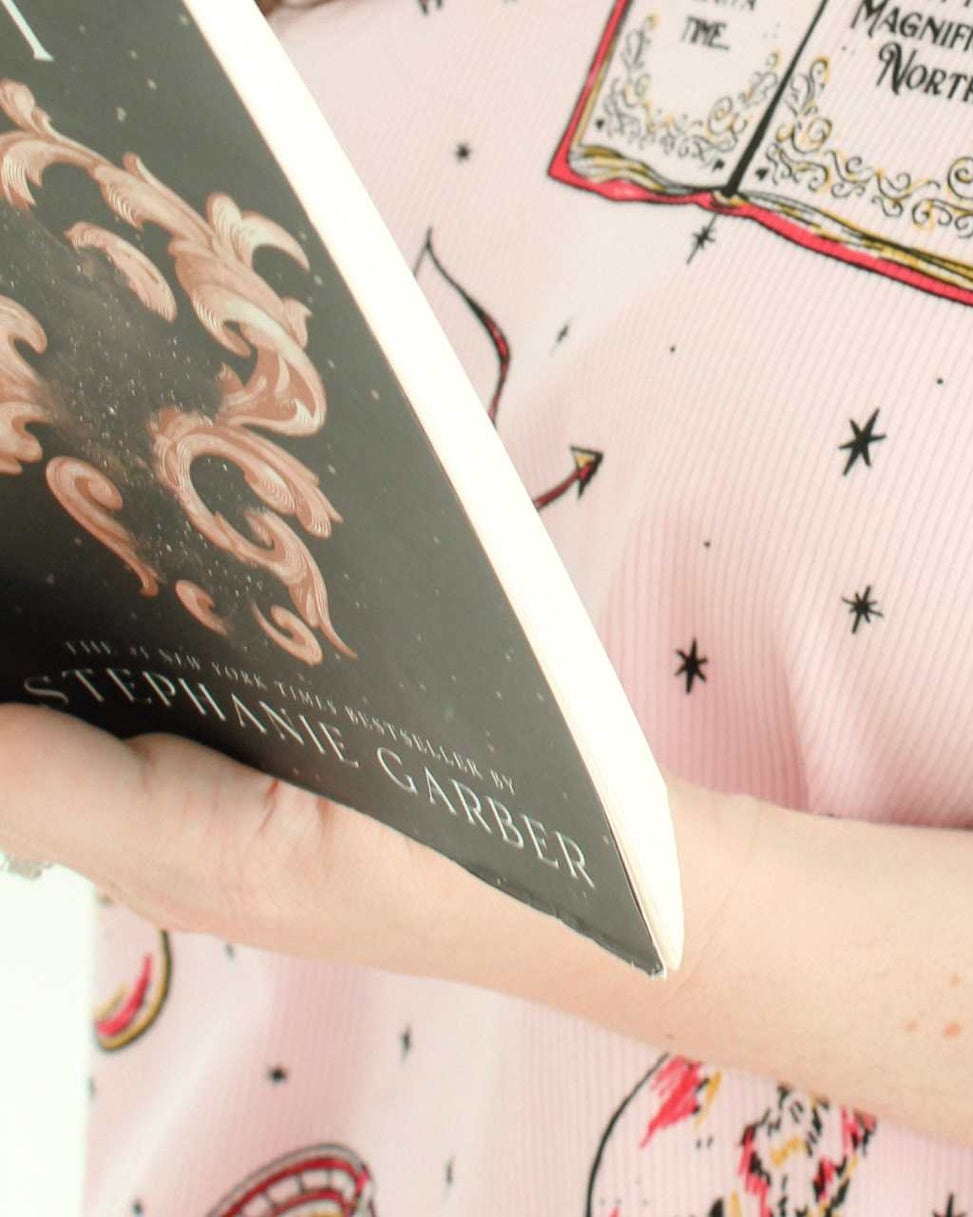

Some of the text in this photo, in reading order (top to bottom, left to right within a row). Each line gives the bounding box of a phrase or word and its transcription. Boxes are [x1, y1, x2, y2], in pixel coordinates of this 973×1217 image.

[211, 661, 268, 691] YORK
[273, 680, 338, 715] TIMES
[23, 667, 596, 890] STEPHANIE GARBER
